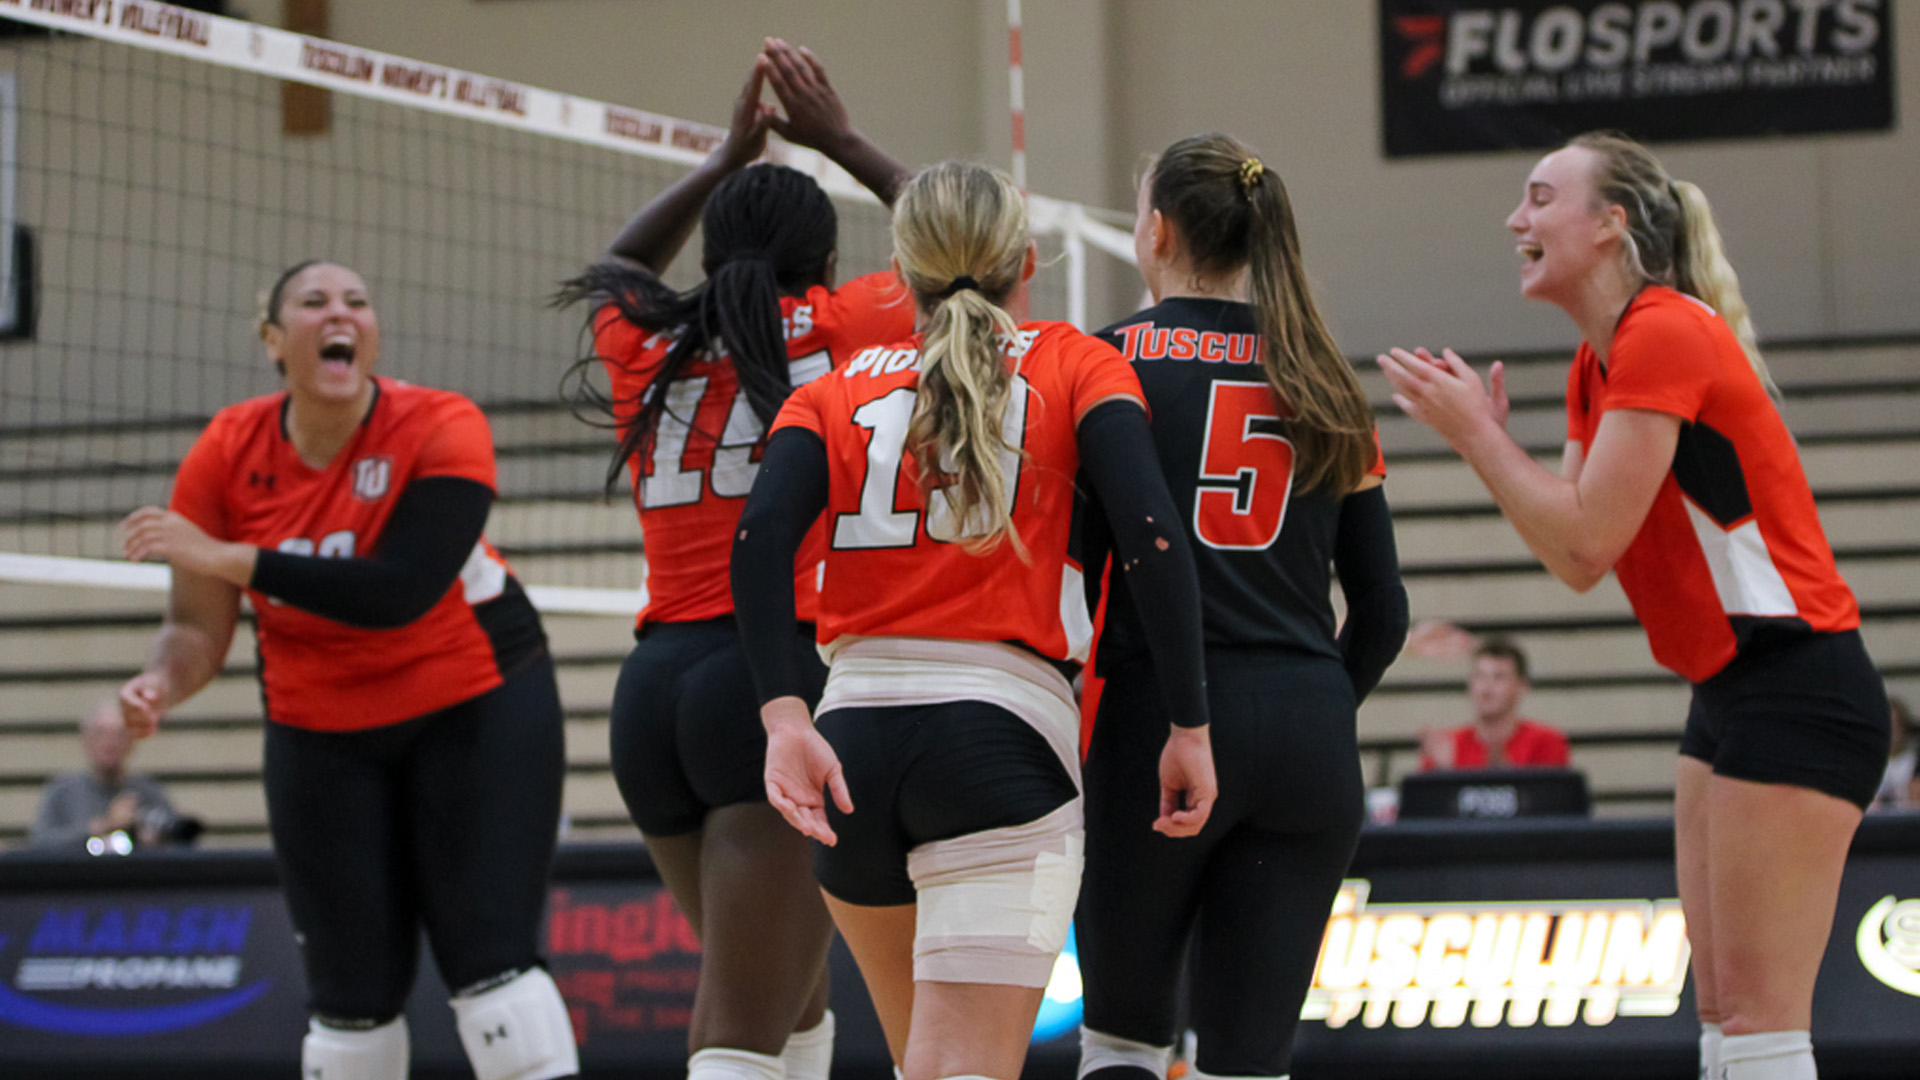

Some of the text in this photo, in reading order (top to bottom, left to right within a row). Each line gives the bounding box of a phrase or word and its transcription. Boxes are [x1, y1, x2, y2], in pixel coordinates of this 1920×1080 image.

[119, 2, 210, 48] VOLLEYBALL
[1443, 0, 1881, 76] FLOSPORTS
[671, 126, 725, 155] WOMEN'
[1114, 321, 1268, 364] TUSCU
[1193, 379, 1298, 551] 5
[28, 904, 252, 952] MARSH
[1310, 888, 1686, 990] USCULUM
[72, 956, 243, 990] PROPANE
